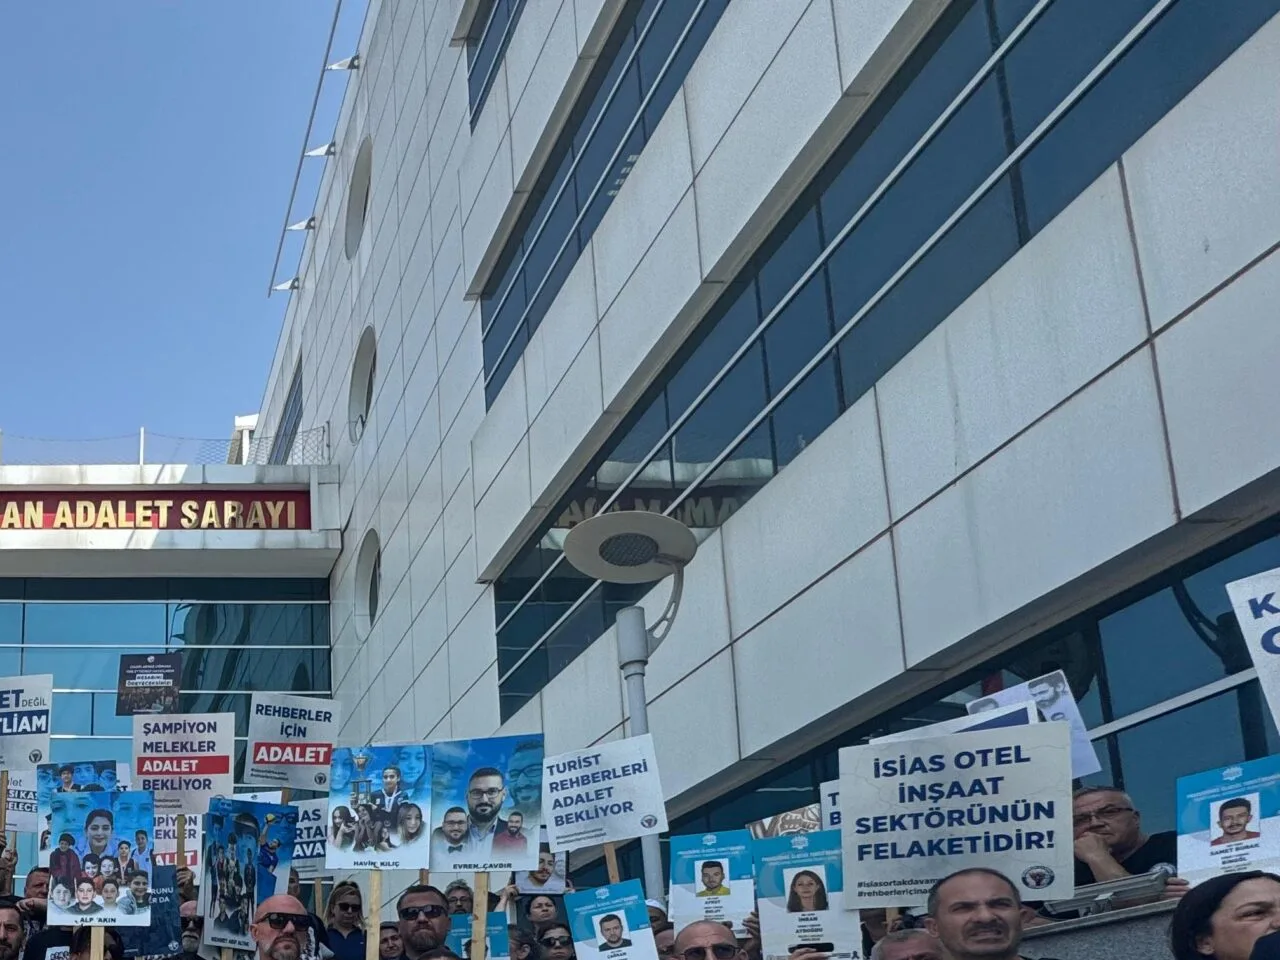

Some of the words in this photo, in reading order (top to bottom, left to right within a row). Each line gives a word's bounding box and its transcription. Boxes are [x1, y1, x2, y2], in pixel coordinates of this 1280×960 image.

[53, 500, 173, 529] ADALET
[181, 500, 297, 529] SARAYI
[22, 697, 47, 708] DEĞİL
[255, 704, 333, 723] REHBERLER
[143, 720, 217, 736] ŞAMPİYON
[280, 722, 307, 738] İÇİN
[143, 741, 216, 753] MELEKLER
[255, 746, 329, 763] ADALET
[142, 760, 198, 772] ADALET
[546, 754, 602, 776] TURİST
[873, 754, 945, 778] İSİAS
[954, 745, 1031, 769] OTEL
[142, 777, 212, 791] BEKLİYOR
[549, 758, 648, 793] REHBERLERİ
[552, 786, 614, 810] ADALET
[898, 776, 1004, 804] İNŞAAT
[6, 801, 37, 813] ELECE
[554, 801, 634, 827] BEKLİYOR
[855, 799, 1054, 835] SEKTÖRÜNÜN
[294, 826, 327, 840] RTA
[858, 829, 1055, 861] FELAKETİDİR!
[857, 877, 938, 888] #isiasortakdavam
